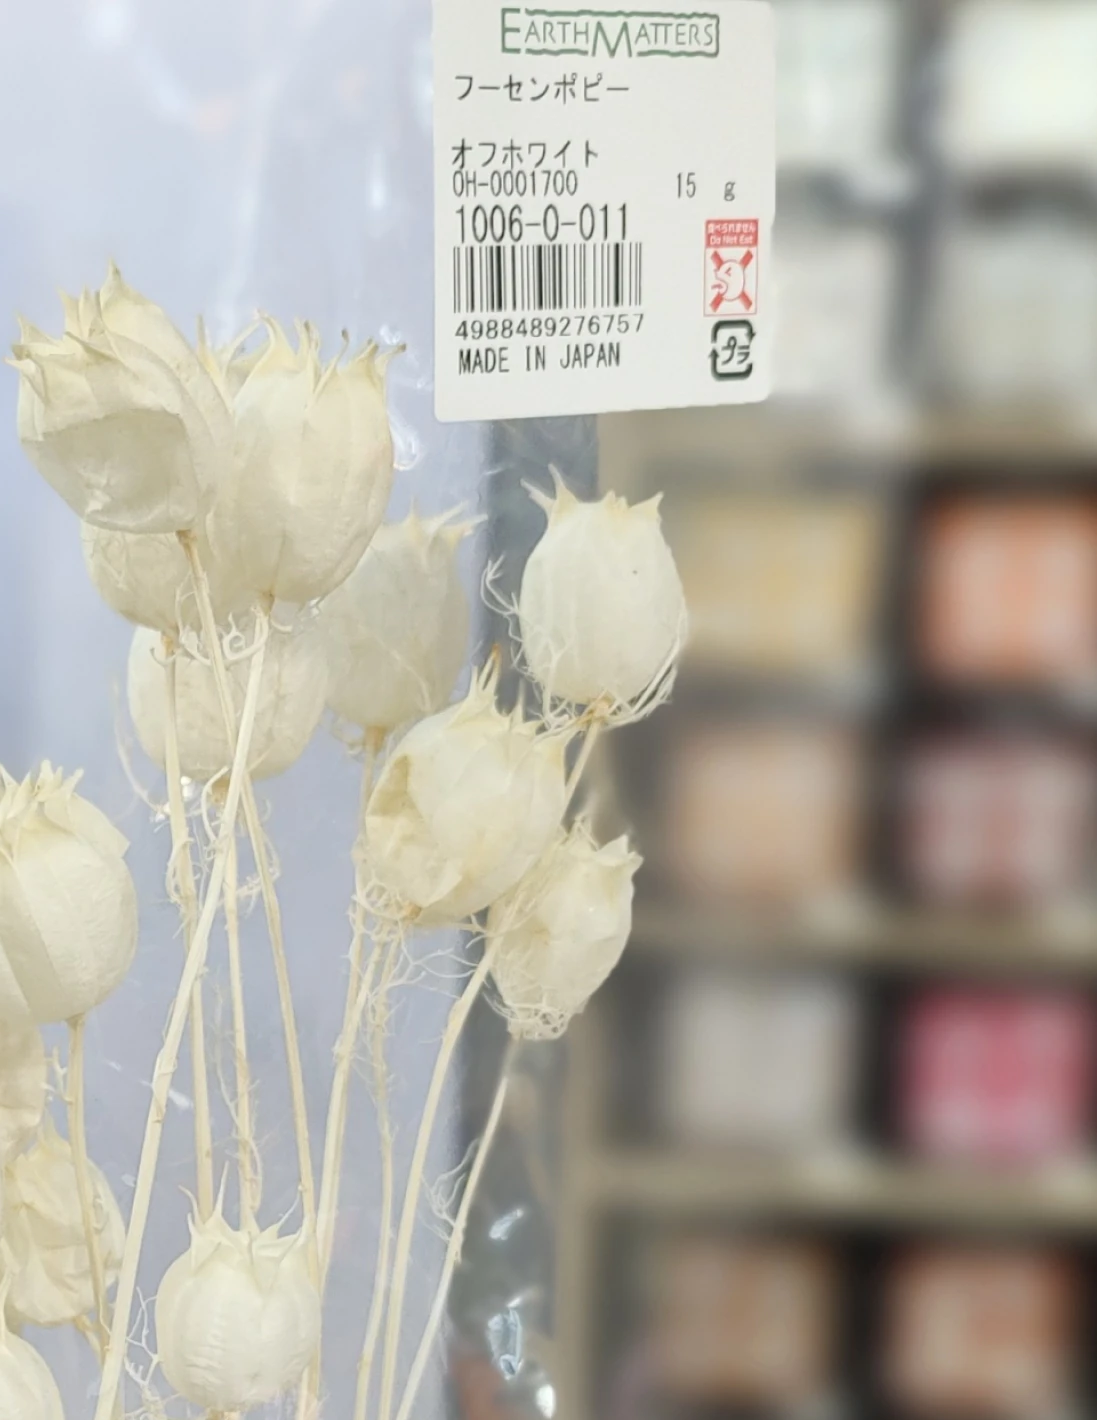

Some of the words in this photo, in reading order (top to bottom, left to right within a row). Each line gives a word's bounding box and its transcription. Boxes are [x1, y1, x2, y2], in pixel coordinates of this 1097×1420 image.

[454, 72, 630, 105] フーセンポピー
[451, 138, 599, 170] オフホワイト
[676, 172, 697, 199] 15
[723, 181, 736, 202] g
[455, 203, 629, 244] 1006-0-011
[454, 314, 644, 340] 4988489276757
[458, 346, 510, 375] MADE
[525, 345, 546, 371] IN
[559, 342, 621, 369] JAPAN
